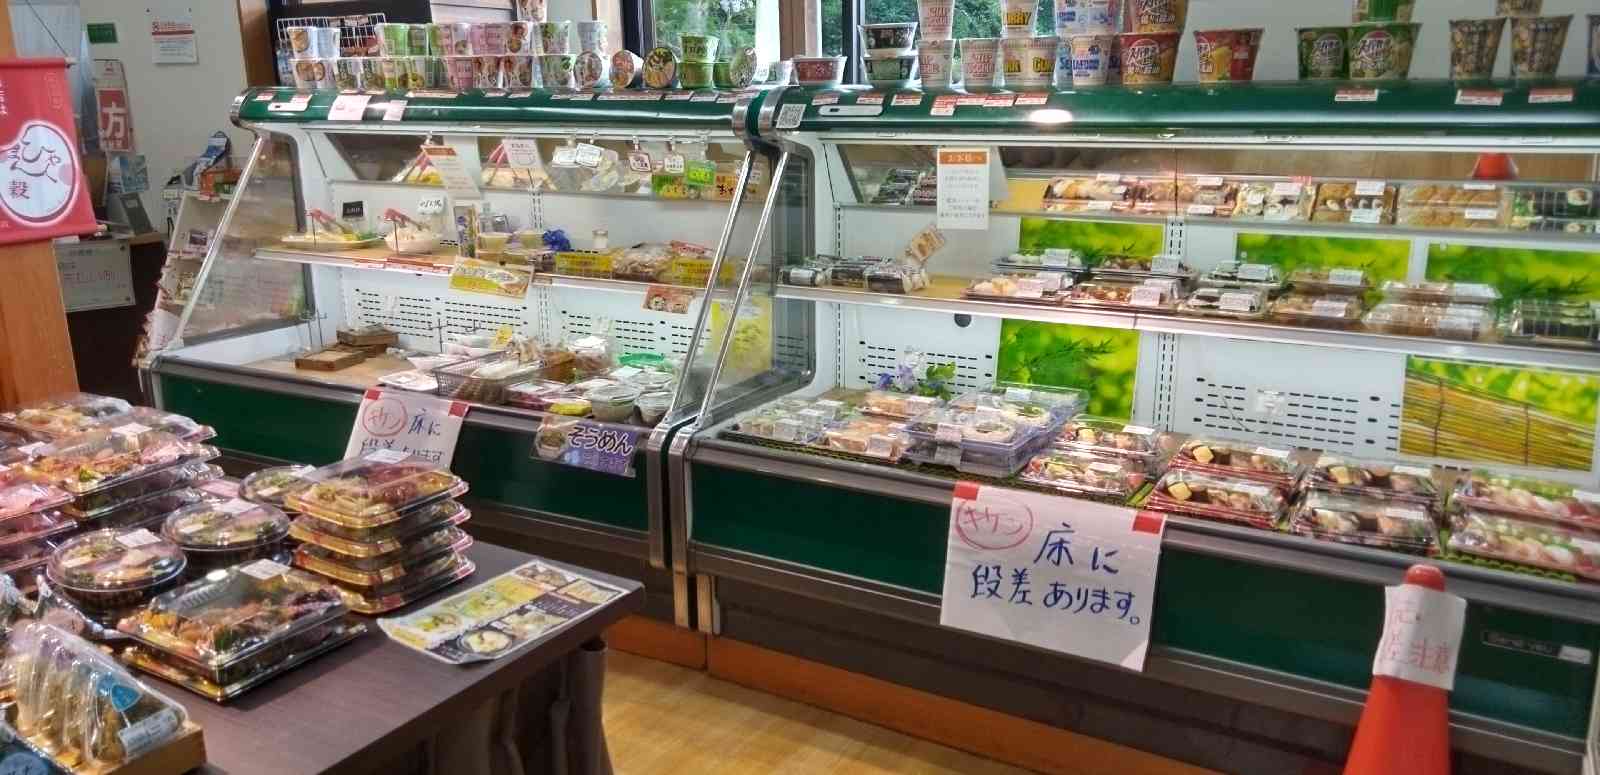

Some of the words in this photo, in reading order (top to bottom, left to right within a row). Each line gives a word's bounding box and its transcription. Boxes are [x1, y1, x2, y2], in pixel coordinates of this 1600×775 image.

[566, 425, 633, 456] そうめん
[962, 506, 1024, 535] キケン
